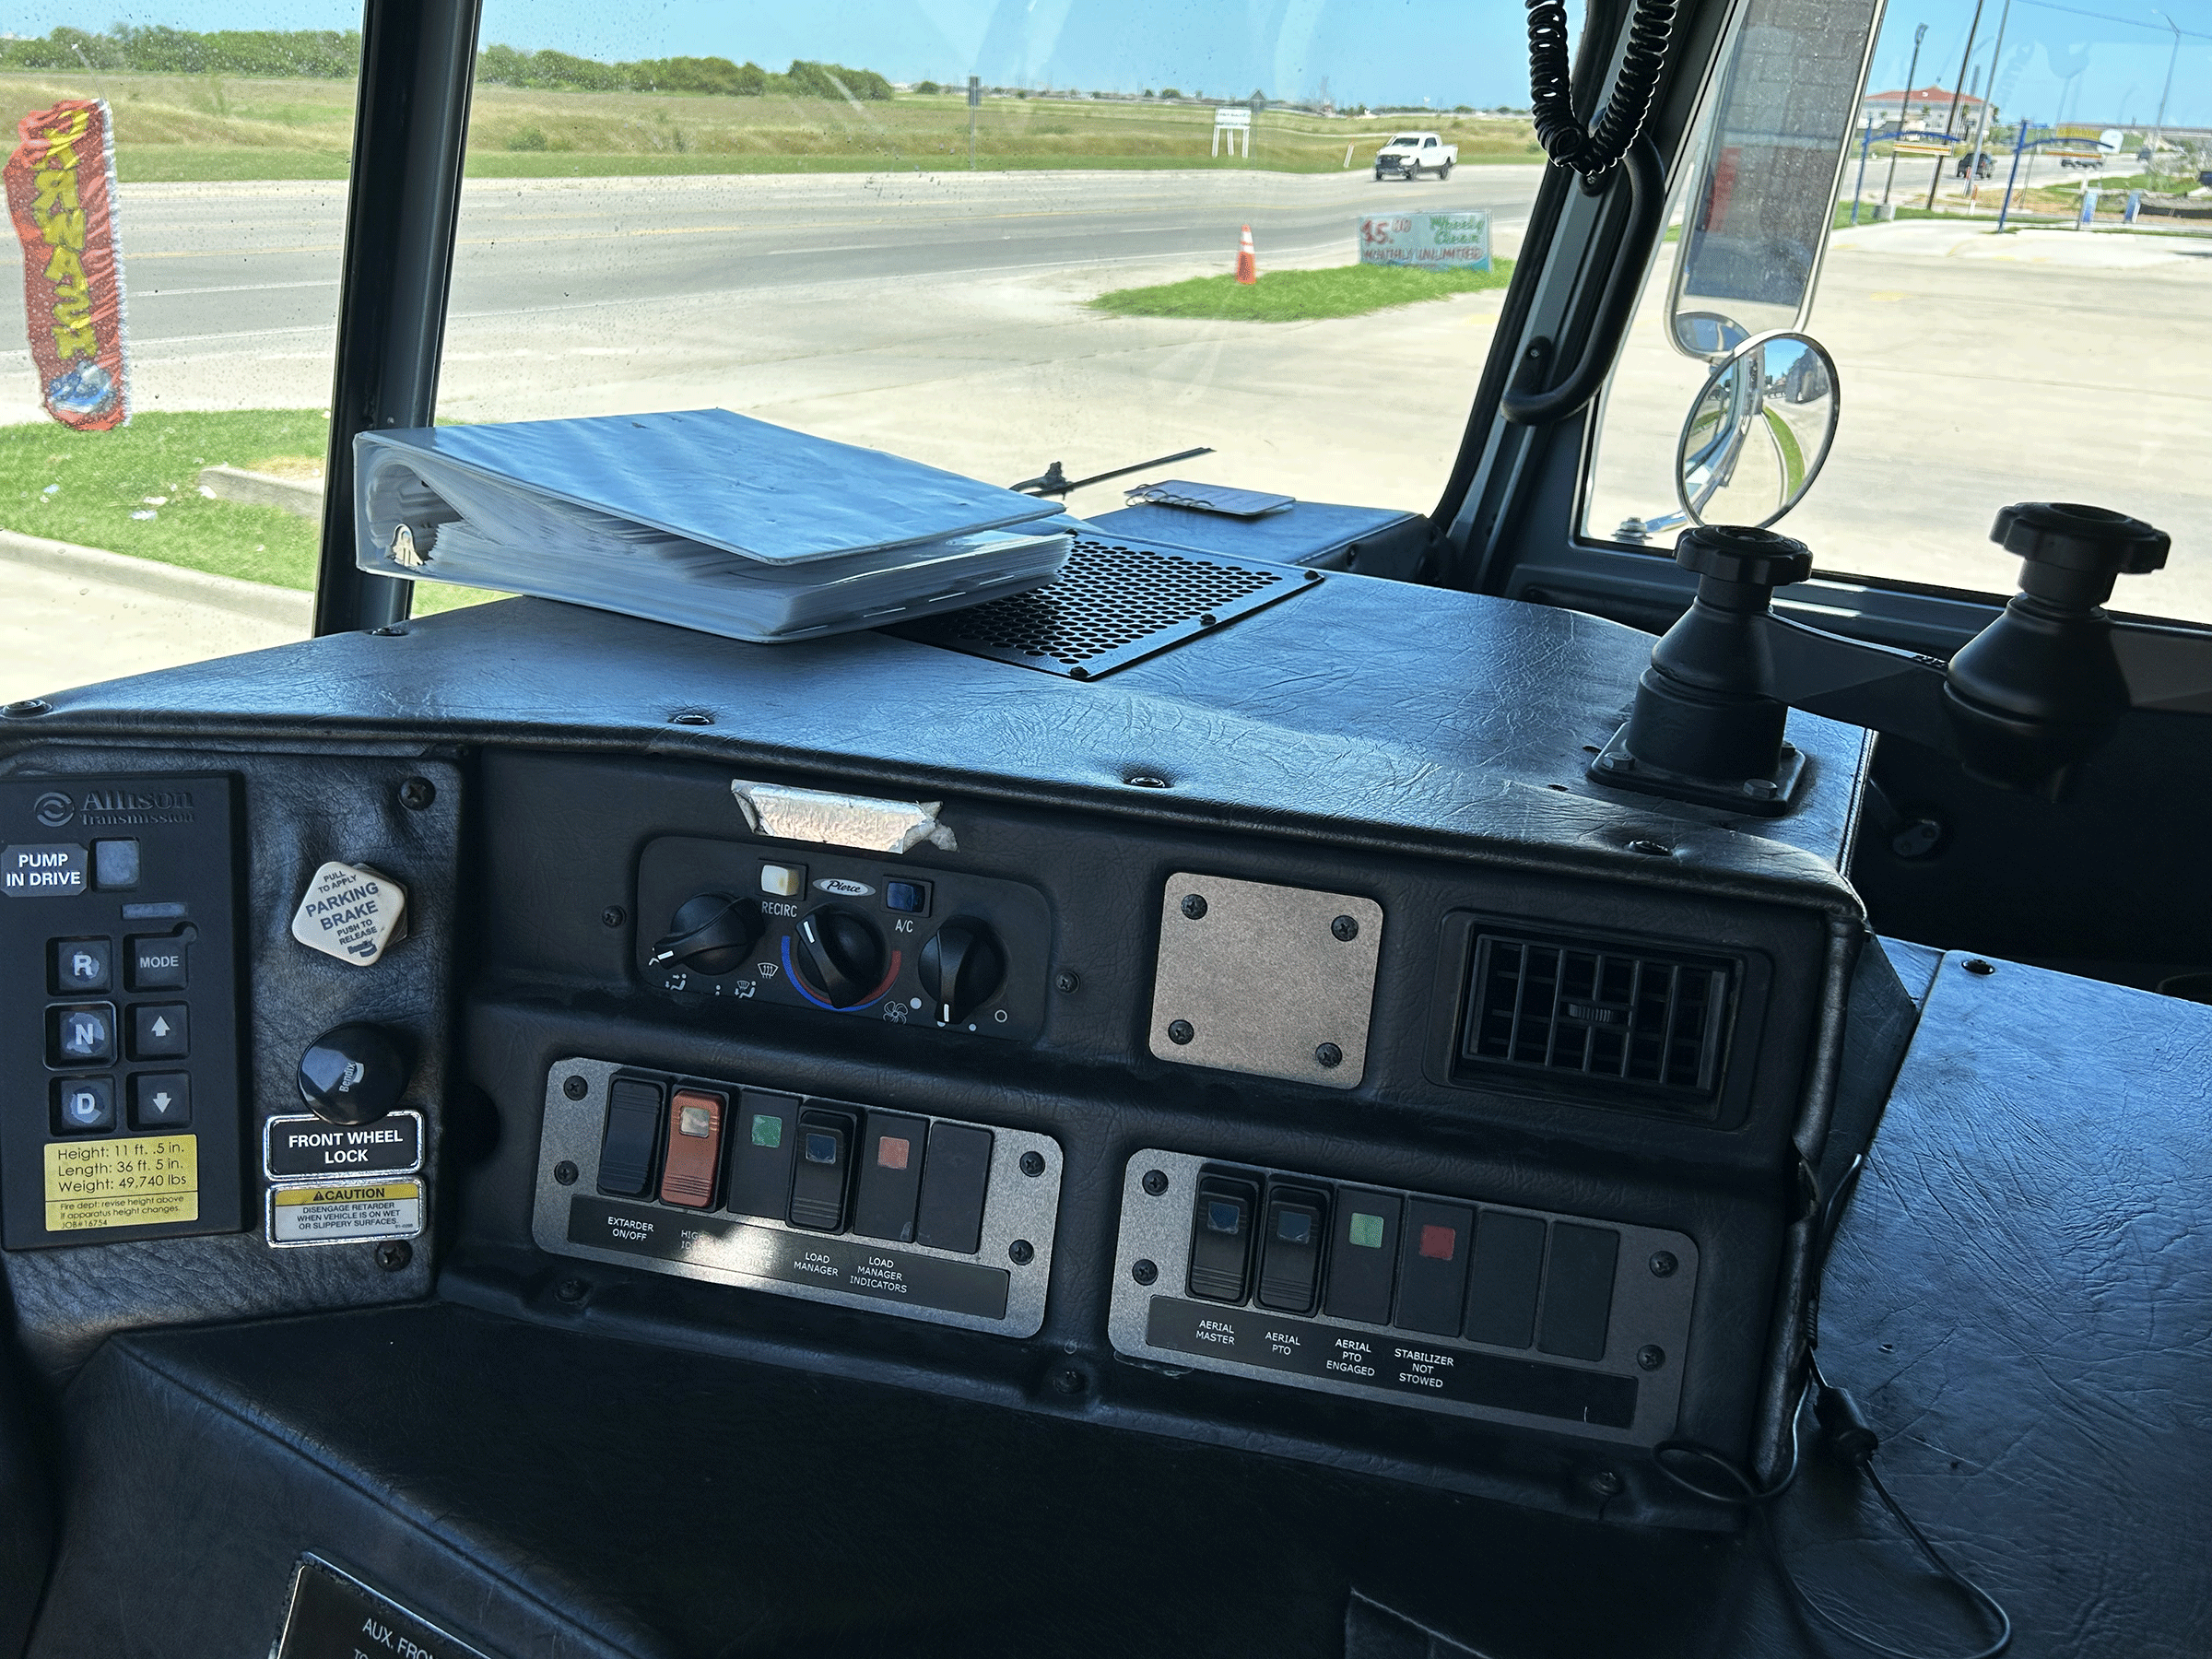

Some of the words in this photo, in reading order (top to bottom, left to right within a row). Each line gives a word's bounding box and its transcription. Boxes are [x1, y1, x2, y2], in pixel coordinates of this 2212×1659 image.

[81, 790, 194, 811] Allison
[81, 813, 194, 826] Transmission
[18, 853, 68, 867] PUMP
[6, 873, 24, 887] IN
[29, 871, 81, 886] DRIVE
[324, 871, 346, 882] PULL
[332, 875, 357, 889] APPLY
[826, 880, 862, 894] Pierce
[305, 882, 379, 917] PARKING
[320, 900, 378, 931] BRAKE
[761, 901, 798, 918] RECIRC
[336, 924, 359, 936] PUSH
[360, 919, 372, 928] TO
[895, 919, 913, 933] A/C
[339, 926, 378, 945] RELEASE
[73, 955, 93, 976] R
[140, 956, 179, 968] MODE
[76, 1023, 93, 1045] N
[338, 1062, 356, 1093] Bendix
[76, 1093, 95, 1114] D
[288, 1133, 343, 1147] FRONT
[347, 1129, 403, 1145] WHEEL
[58, 1147, 109, 1161] Height:
[116, 1145, 128, 1156] 11
[134, 1144, 147, 1155] ft.
[153, 1143, 165, 1154] .5
[169, 1142, 184, 1153] in.
[324, 1149, 369, 1164] LOCK
[58, 1163, 112, 1177] Length:
[117, 1161, 134, 1172] 36
[137, 1159, 150, 1171] ft.
[156, 1159, 164, 1170] 5
[168, 1159, 183, 1169] in.
[59, 1179, 113, 1193] Weight:
[119, 1174, 164, 1189] 49,740
[168, 1174, 186, 1185] lbs
[101, 1199, 125, 1207] revise
[127, 1197, 154, 1206] height
[157, 1195, 183, 1204] above
[324, 1188, 385, 1200] CAUTION
[67, 1209, 111, 1220] apparatus
[112, 1206, 139, 1217] height
[302, 1205, 350, 1214] DISENGAGE
[352, 1202, 395, 1211] RETARDER
[62, 1219, 108, 1229] JOB#16754
[297, 1214, 322, 1222] WHEN
[324, 1212, 358, 1220] VEHICLE
[607, 1217, 654, 1232] EXTARDER
[312, 1220, 352, 1230] SLIPPERY
[612, 1229, 647, 1241] ON/OFF
[805, 1252, 830, 1264] LOAD
[868, 1256, 894, 1268] LOAD
[794, 1261, 839, 1277] MANAGER
[857, 1265, 903, 1281] MANAGER
[850, 1276, 908, 1293] INDICATORS
[1199, 1320, 1234, 1334] AERIAL
[1195, 1331, 1235, 1345] MASTER
[1265, 1332, 1300, 1346] AERIAL
[1335, 1338, 1371, 1353] AERIAL
[1272, 1344, 1291, 1356] PTO
[1342, 1351, 1362, 1362] PTO
[1394, 1348, 1454, 1366] STABILIZER
[1326, 1360, 1375, 1376] ENGAGED
[1412, 1363, 1434, 1374] NOT
[1399, 1372, 1443, 1388] STOWED
[362, 1618, 394, 1649] AUX.
[397, 1637, 434, 1659] FRO
